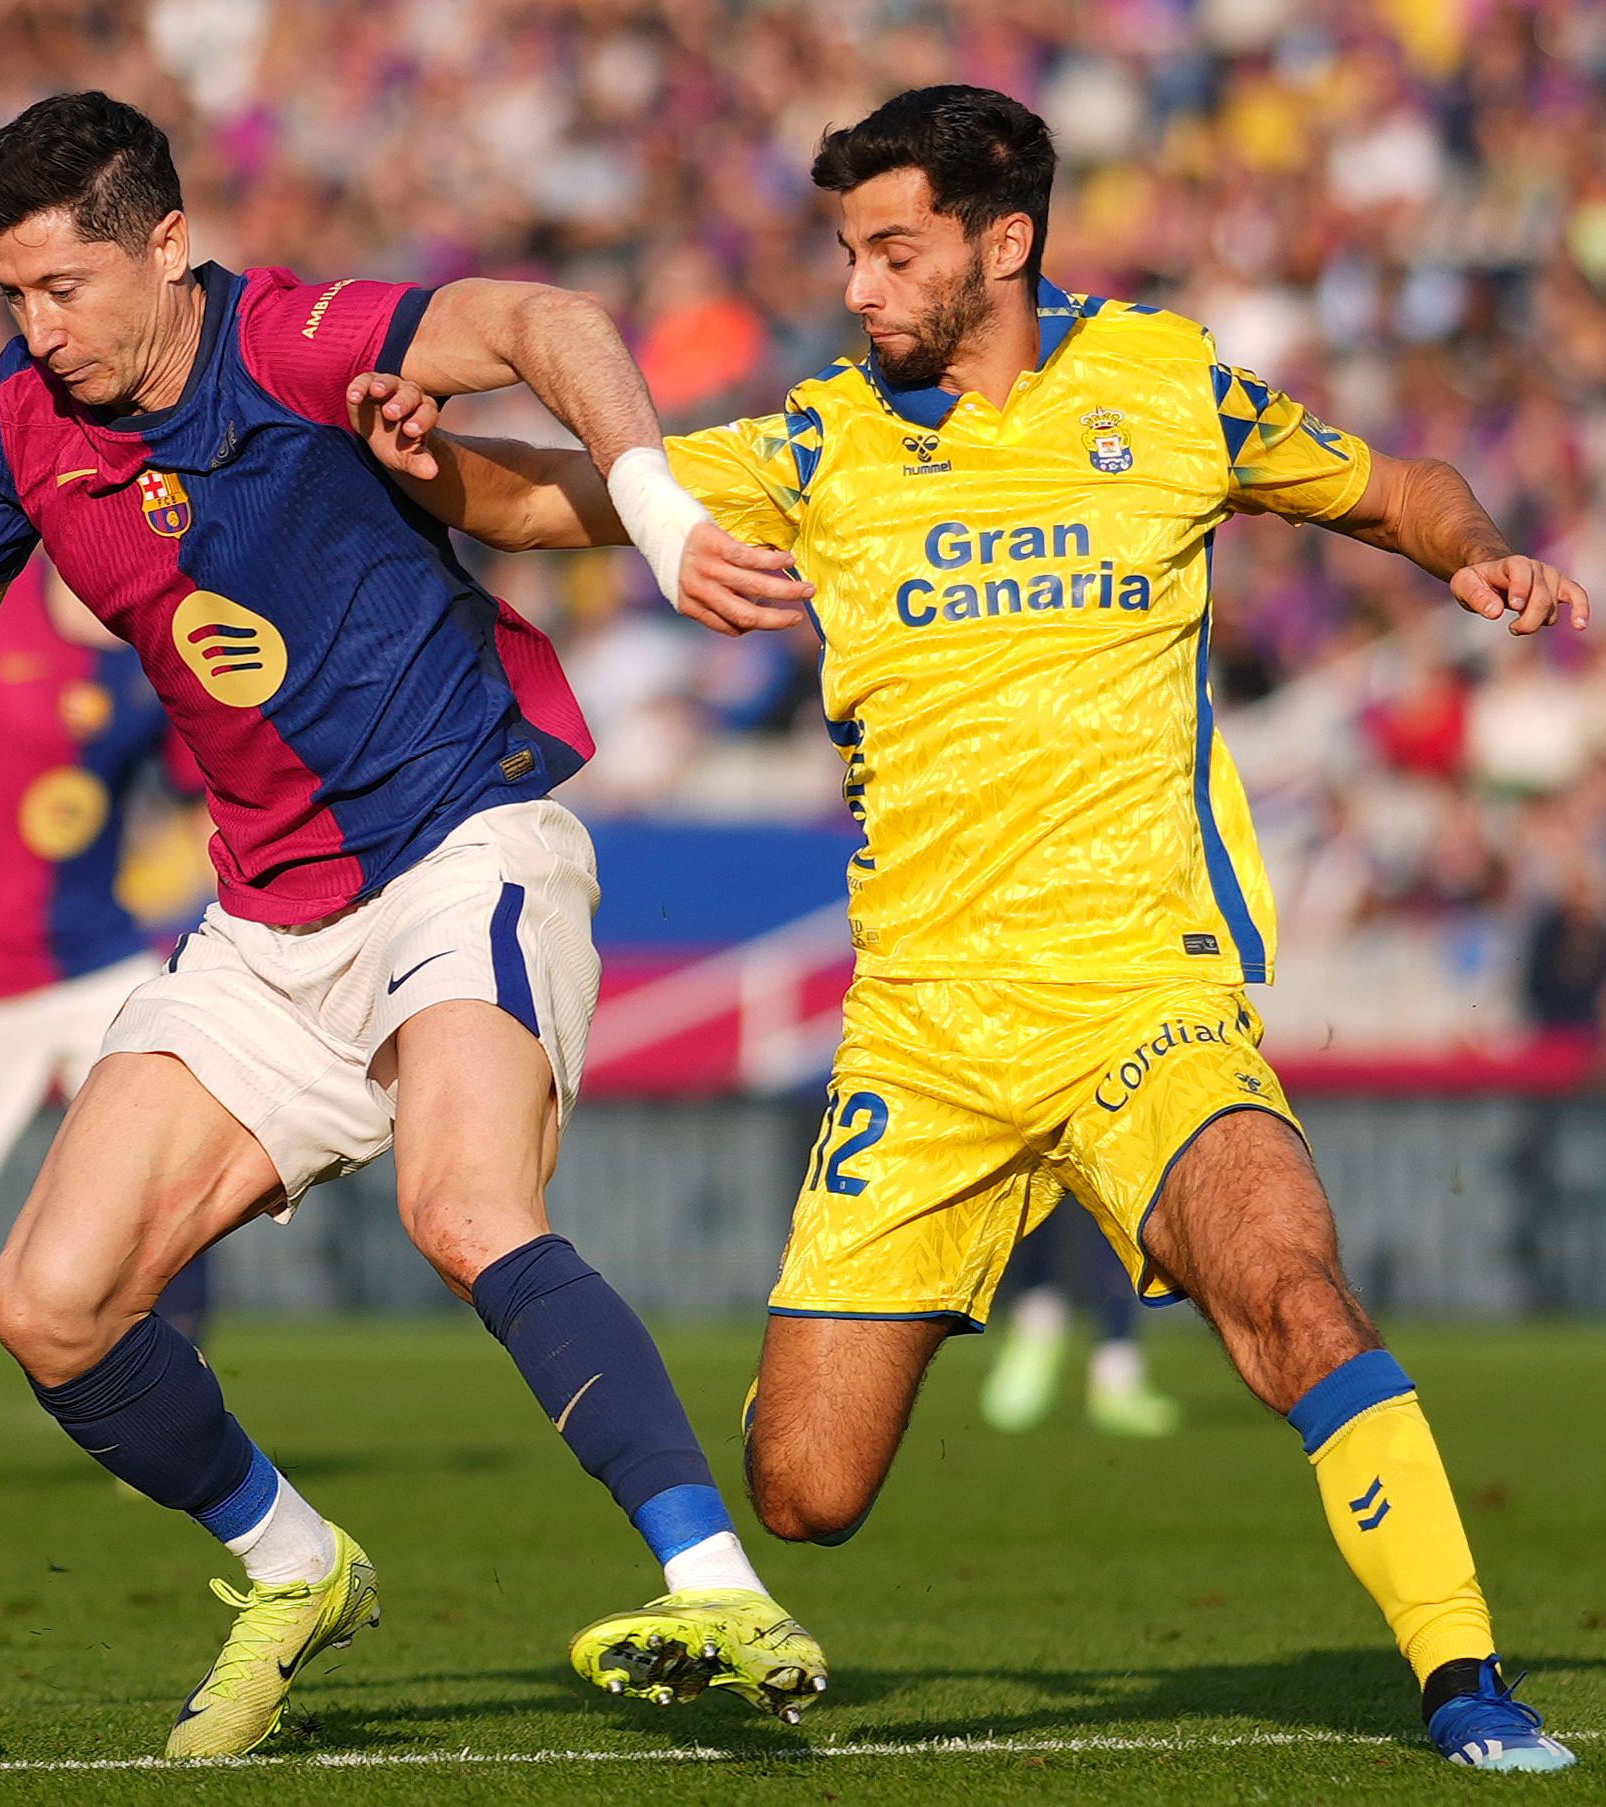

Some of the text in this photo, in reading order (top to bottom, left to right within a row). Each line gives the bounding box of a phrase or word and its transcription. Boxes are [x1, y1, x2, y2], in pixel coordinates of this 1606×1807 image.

[902, 460, 952, 477] hummel
[924, 521, 1090, 570] Gran
[896, 561, 1151, 628] Canaria
[1095, 1019, 1230, 1112] Cordial
[809, 1090, 889, 1197] 12
